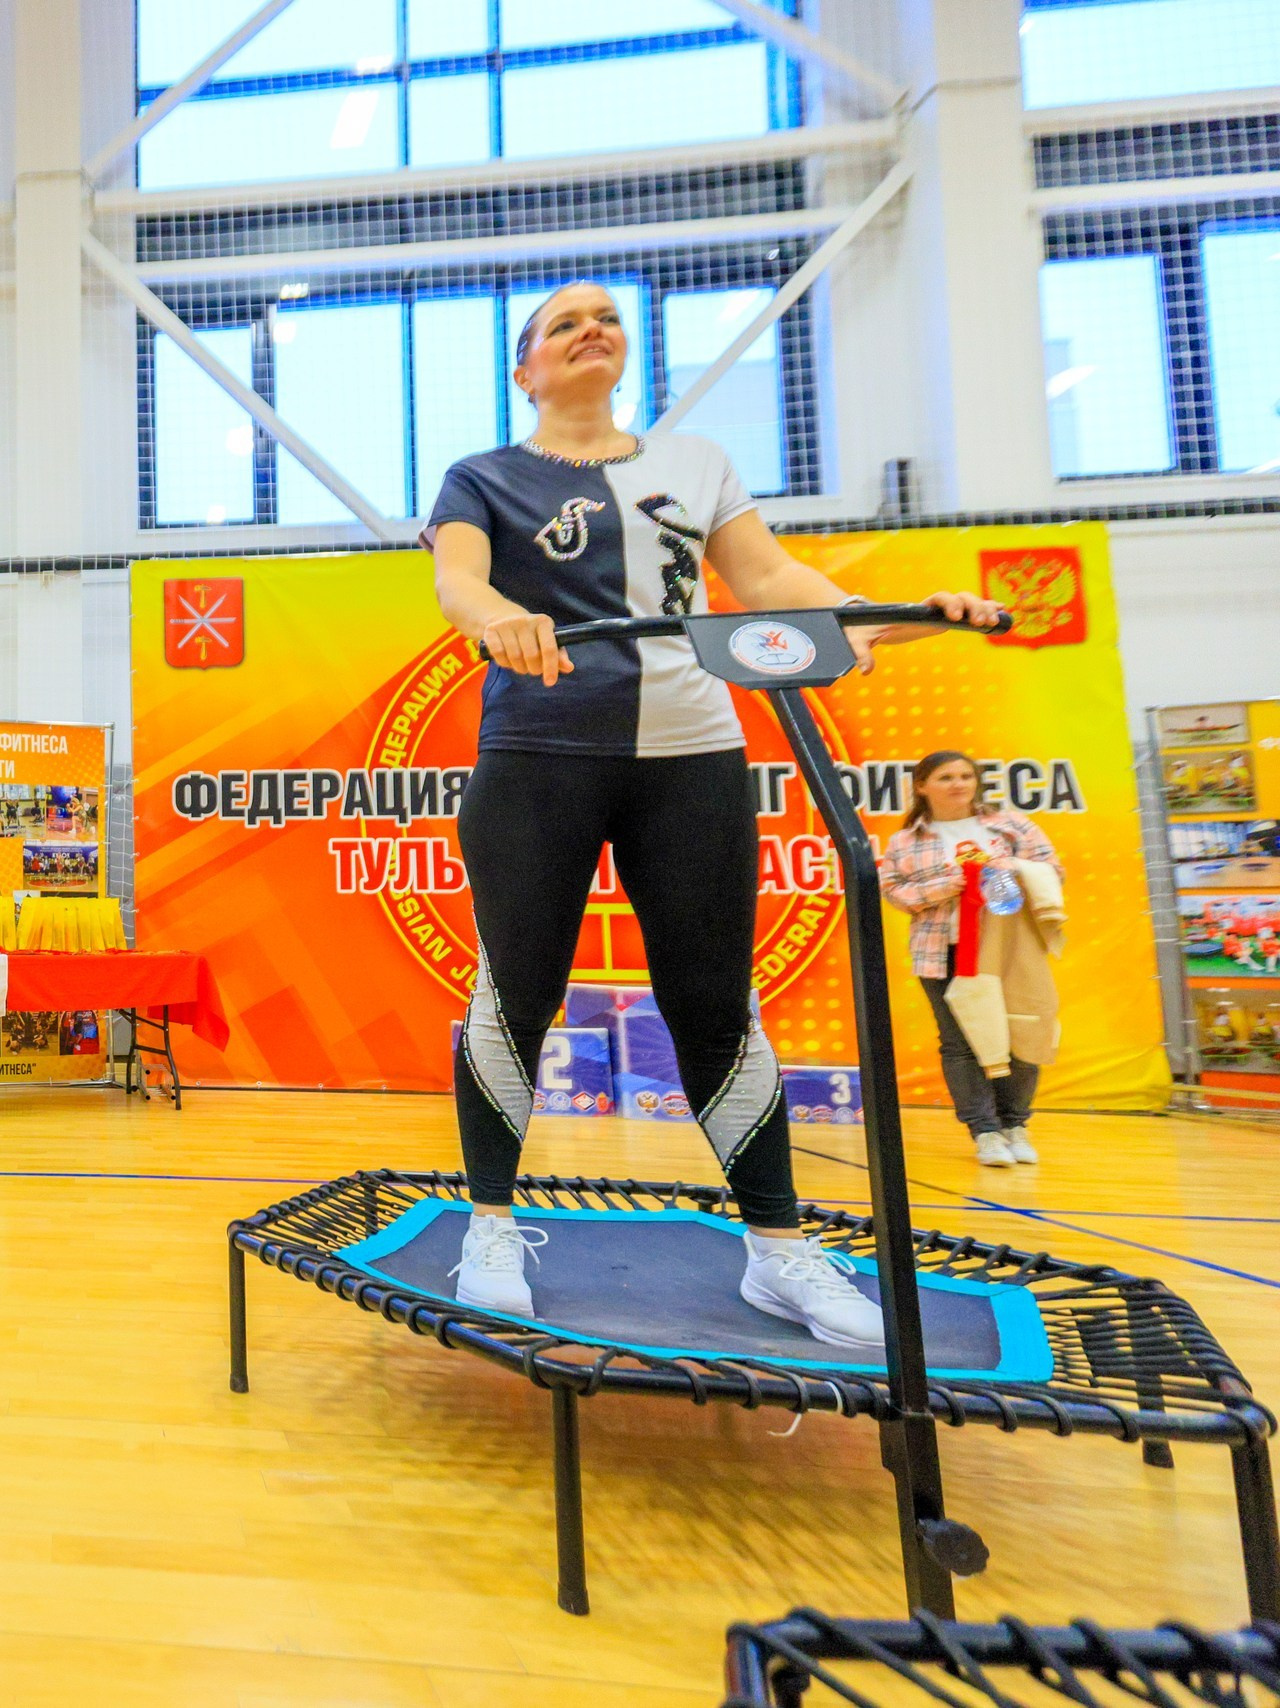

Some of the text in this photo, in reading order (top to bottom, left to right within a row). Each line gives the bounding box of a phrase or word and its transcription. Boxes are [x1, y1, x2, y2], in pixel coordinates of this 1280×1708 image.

[379, 652, 464, 769] ДЕРАЦИЯ
[173, 767, 473, 826] ФЕДЕРАЦИЯ
[543, 1036, 573, 1090] 2
[829, 1073, 851, 1105] 3
